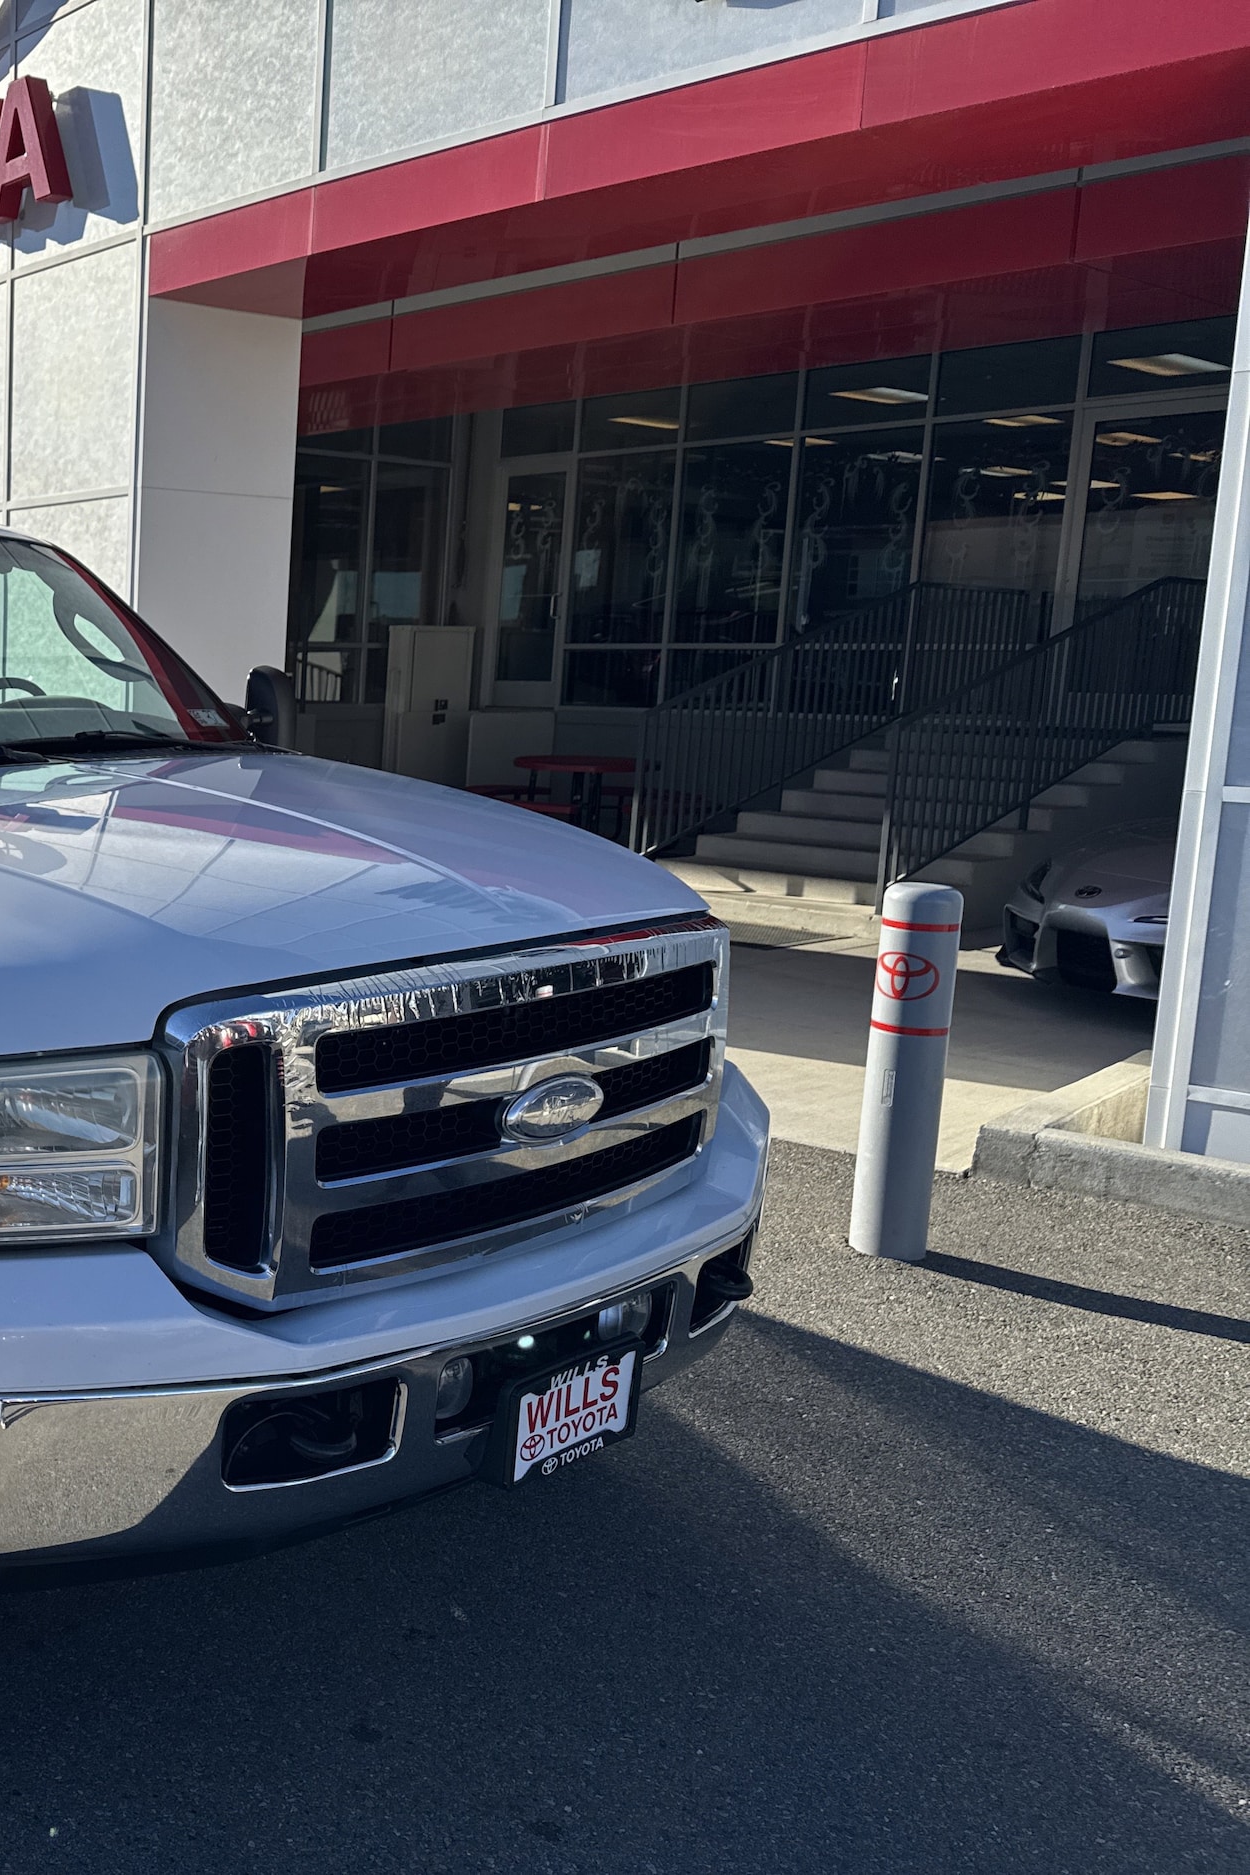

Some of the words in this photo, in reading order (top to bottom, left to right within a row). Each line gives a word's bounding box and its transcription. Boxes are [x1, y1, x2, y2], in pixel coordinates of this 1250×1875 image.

[551, 1355, 609, 1390] WILLS
[527, 1366, 620, 1433] WILLS
[546, 1403, 618, 1449] TOYOTA
[560, 1436, 604, 1466] TOYOTA
